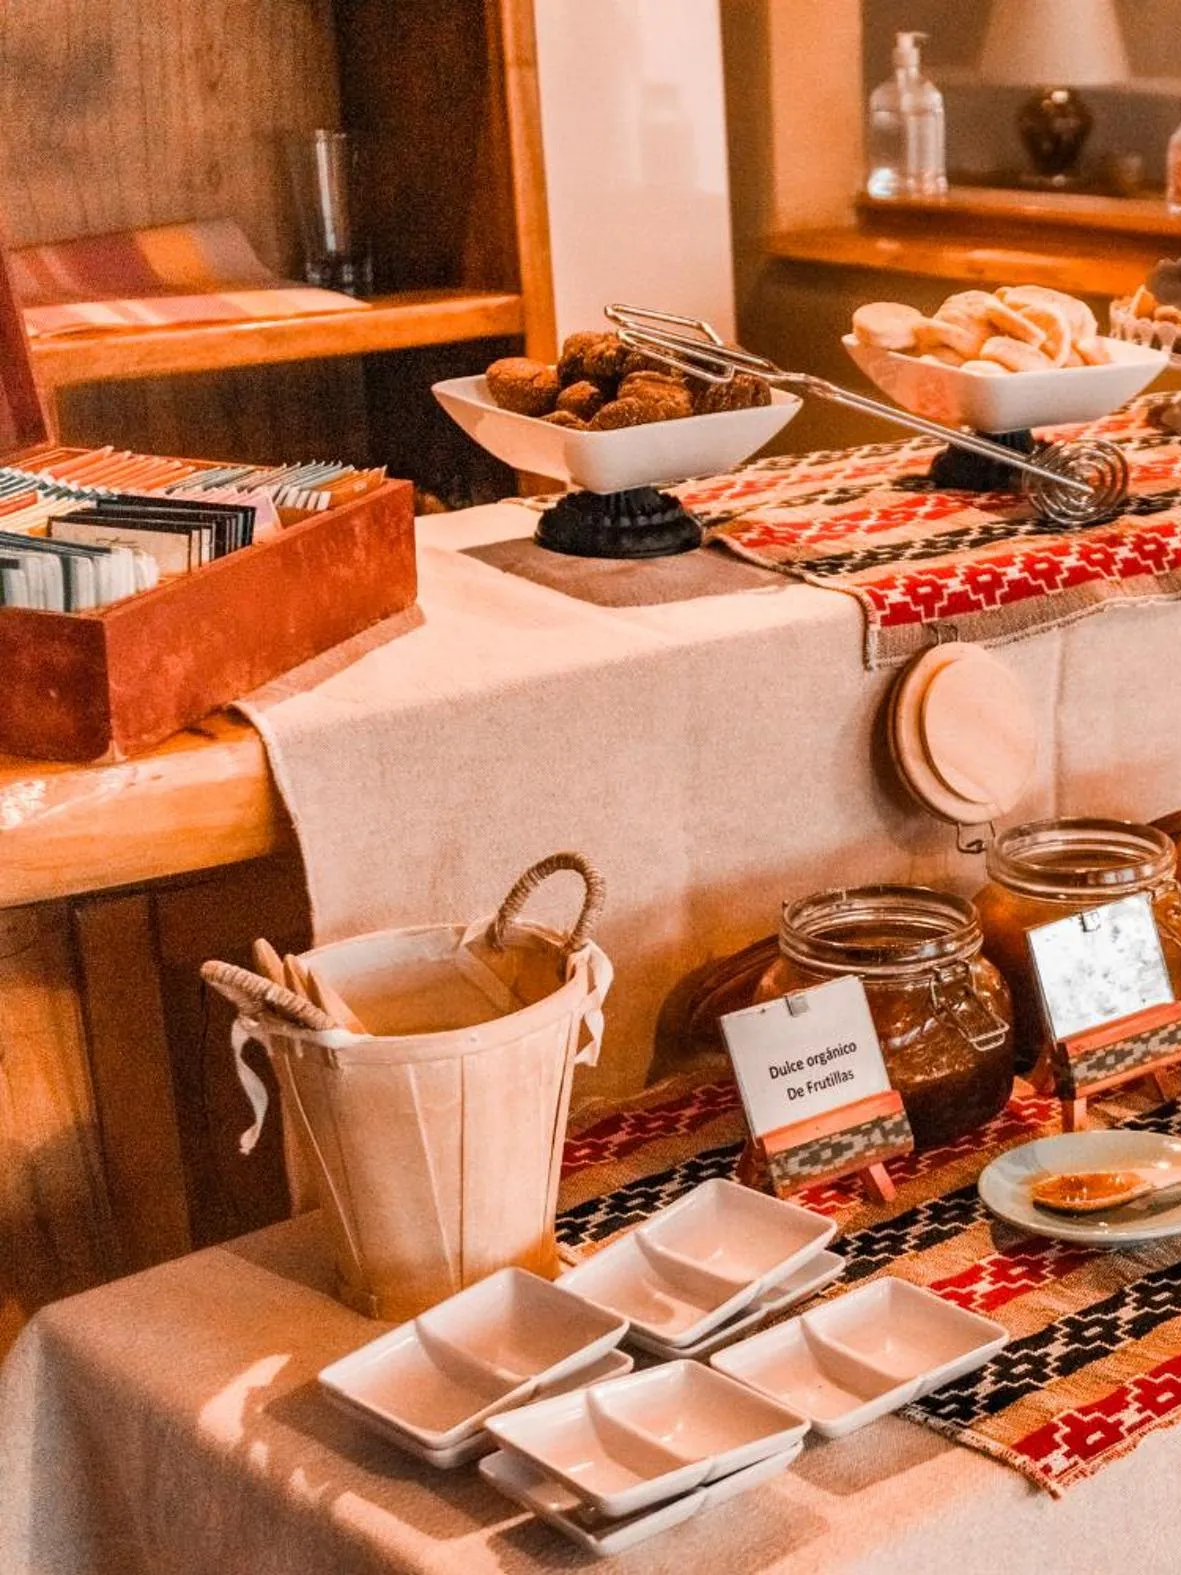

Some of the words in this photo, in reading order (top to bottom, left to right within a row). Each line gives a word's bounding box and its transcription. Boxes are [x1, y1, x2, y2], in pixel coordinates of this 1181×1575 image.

[769, 1059, 805, 1079] Dulce
[806, 1041, 857, 1067] orgánico
[786, 1086, 805, 1101] De
[805, 1070, 855, 1095] Frutillas
